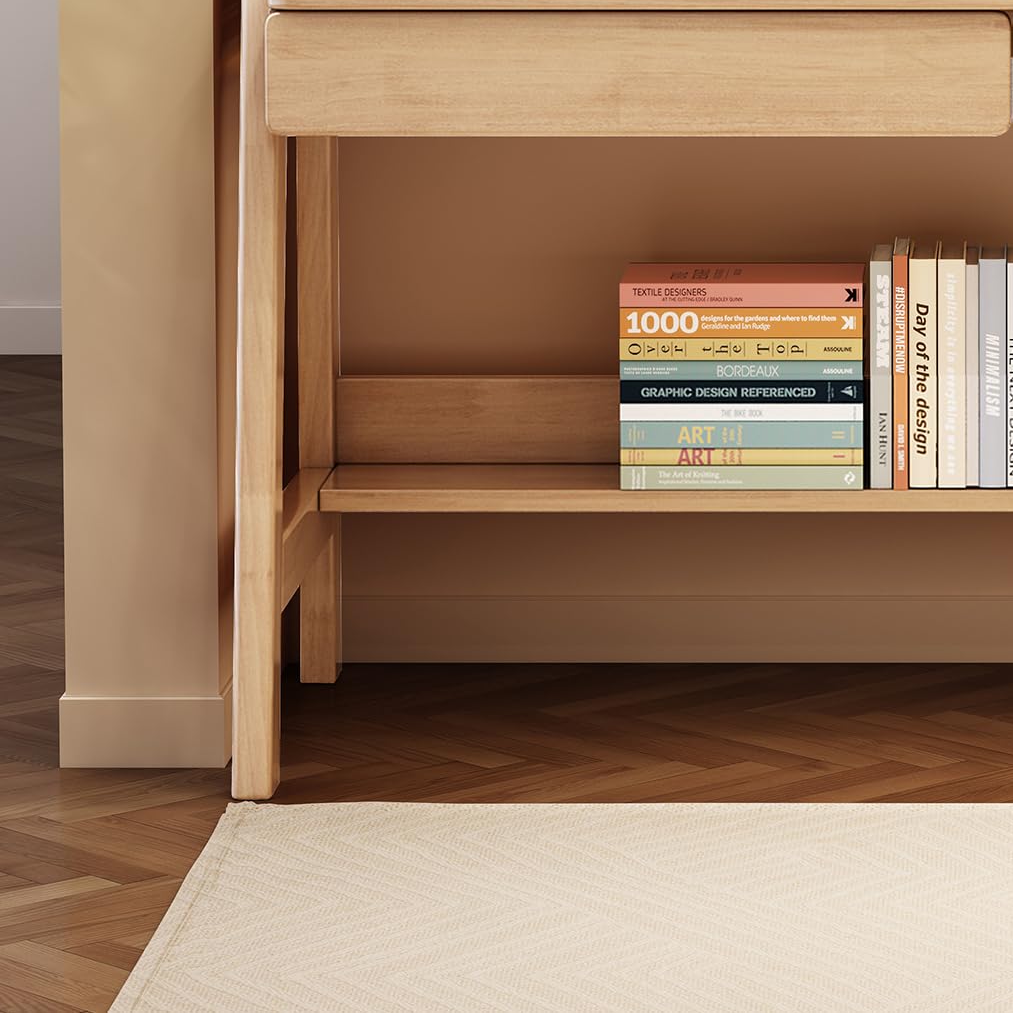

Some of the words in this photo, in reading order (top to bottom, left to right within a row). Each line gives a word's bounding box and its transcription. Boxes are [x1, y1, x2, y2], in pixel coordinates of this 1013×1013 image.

[632, 288, 662, 297] TEXTILE
[664, 288, 707, 297] DESIGNERS
[626, 311, 698, 334] 1000
[700, 315, 724, 323] designs
[724, 315, 734, 323] for
[734, 315, 744, 323] the
[744, 315, 769, 323] gardens
[770, 315, 780, 323] and
[781, 315, 800, 323] where
[801, 315, 808, 323] to
[808, 315, 820, 323] find
[821, 315, 837, 323] them
[701, 323, 730, 331] Geraldine
[752, 323, 771, 331] Rudge
[912, 303, 929, 337] Day
[895, 287, 906, 374] #DISRUPTMENOW
[628, 343, 684, 356] Over
[702, 343, 743, 355] the
[756, 343, 804, 355] Top
[916, 338, 930, 361] of
[716, 365, 780, 378] BORDEAUX
[916, 363, 930, 393] the
[985, 333, 1000, 417] MINIMALISM
[640, 387, 692, 398] GRAPHIC
[696, 387, 738, 398] DESIGN
[741, 387, 816, 398] REFERENCED
[879, 412, 888, 432] IAN
[912, 397, 930, 455] design
[677, 426, 716, 444] ART
[677, 448, 716, 465] ART
[879, 433, 888, 466] HUNT
